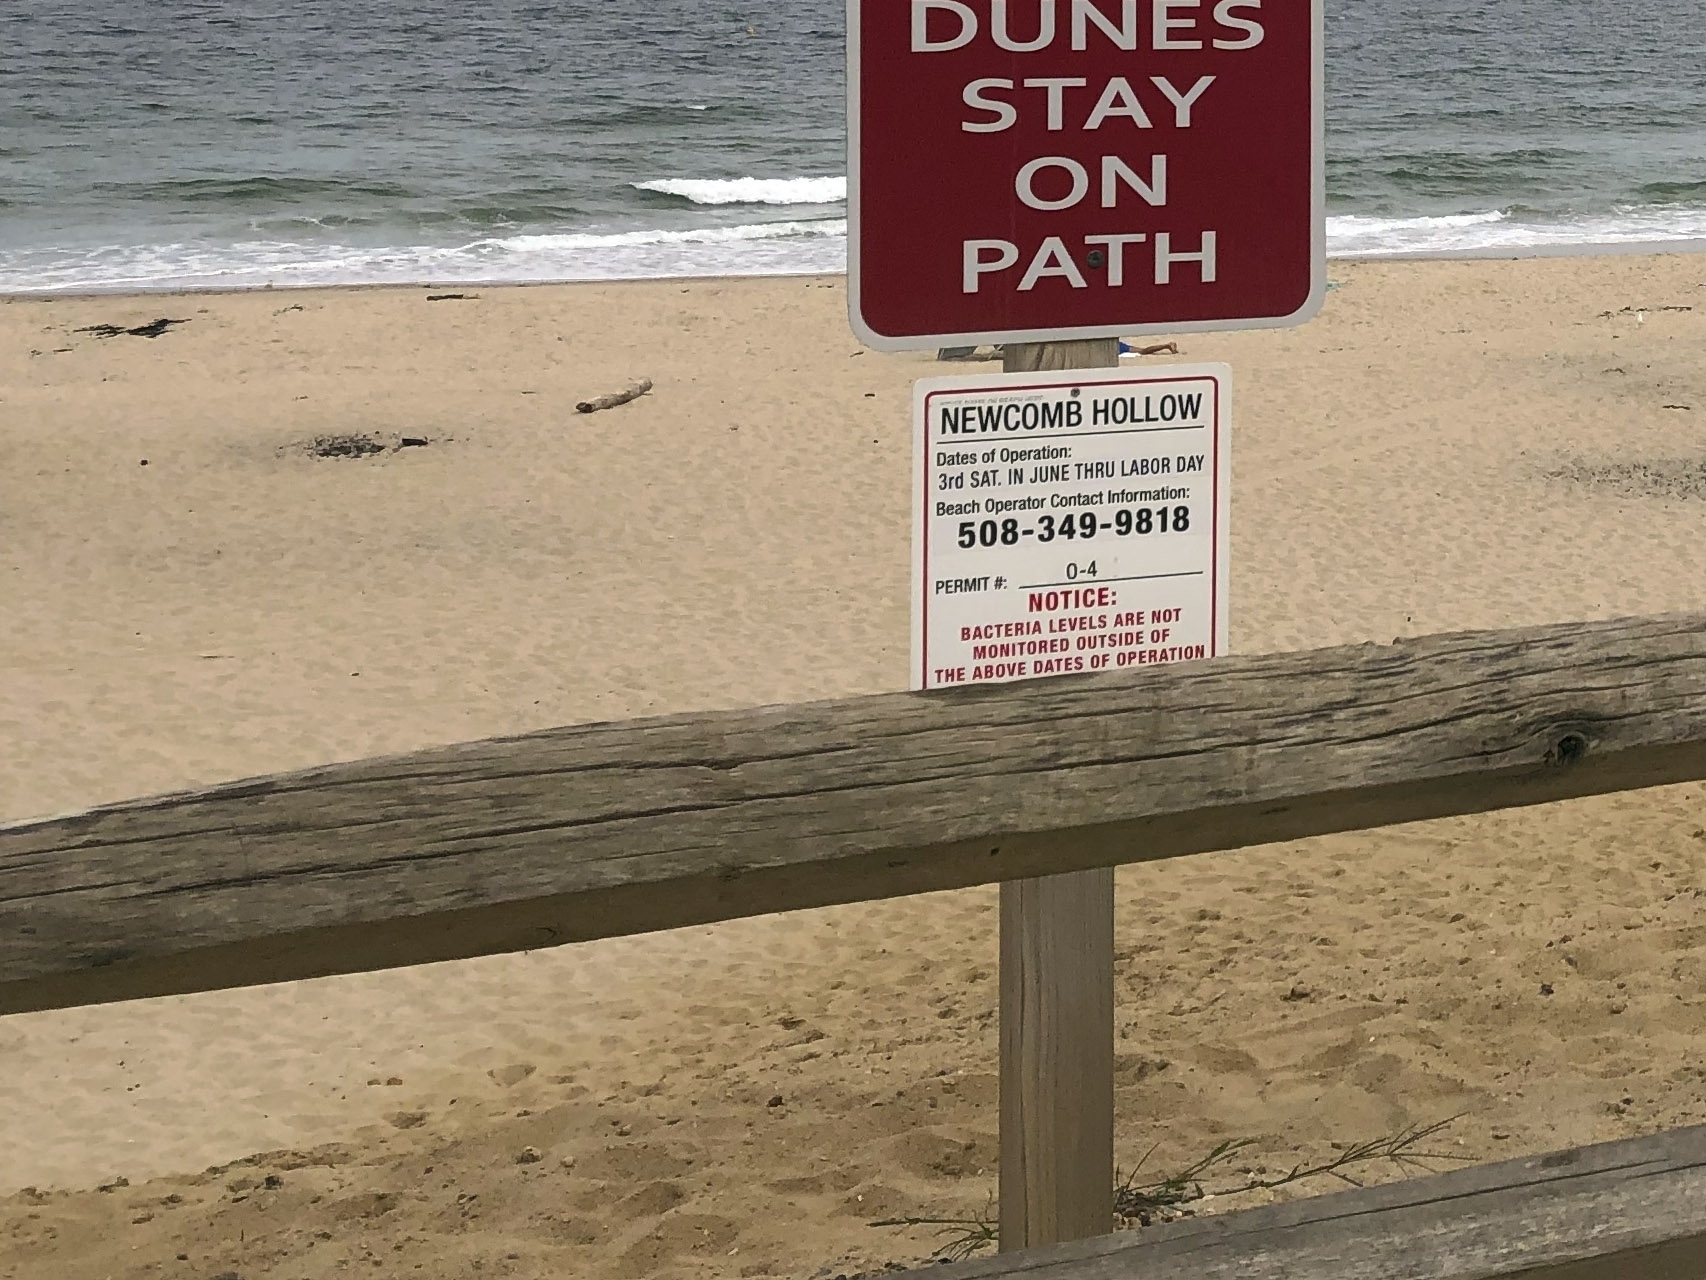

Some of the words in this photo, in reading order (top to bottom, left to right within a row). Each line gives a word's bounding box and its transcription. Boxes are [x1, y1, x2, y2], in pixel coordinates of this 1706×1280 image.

[961, 75, 1216, 133] STAY
[1015, 154, 1166, 210] ON
[963, 230, 1216, 293] PATH
[941, 400, 1082, 434] NEWCOMB
[1092, 392, 1202, 425] HOLLOW
[936, 451, 977, 466] Dates
[981, 448, 996, 463] of
[999, 445, 1071, 464] Operation:
[938, 471, 964, 490] 3rd
[970, 469, 1001, 488] SAT.
[1008, 467, 1023, 485] IN
[1029, 463, 1069, 483] JUNE
[1074, 460, 1115, 480] THRU
[1121, 457, 1170, 477] LABOR
[1176, 454, 1204, 473] DAY
[936, 499, 980, 516] Beach
[985, 496, 1046, 515] Operator
[1050, 490, 1103, 508] Contact
[1107, 486, 1189, 504] Information:
[958, 505, 1189, 548] 508-349-9818
[935, 576, 990, 595] PERMIT
[994, 576, 1007, 590] #:
[1029, 587, 1116, 612] NOTICE:
[961, 620, 1042, 641] BACTERIA
[1049, 614, 1106, 633] LEVELS
[1113, 611, 1144, 627] ARE
[1151, 607, 1181, 624] NOT
[973, 638, 1069, 659] MONITORED
[1076, 630, 1144, 650] OUTSIDE
[1150, 628, 1170, 643] OF
[934, 667, 965, 683] THE
[972, 661, 1026, 680] ABOVE
[1033, 656, 1085, 674] DATES
[1090, 653, 1110, 669] OF
[1116, 644, 1204, 666] OPERATION
